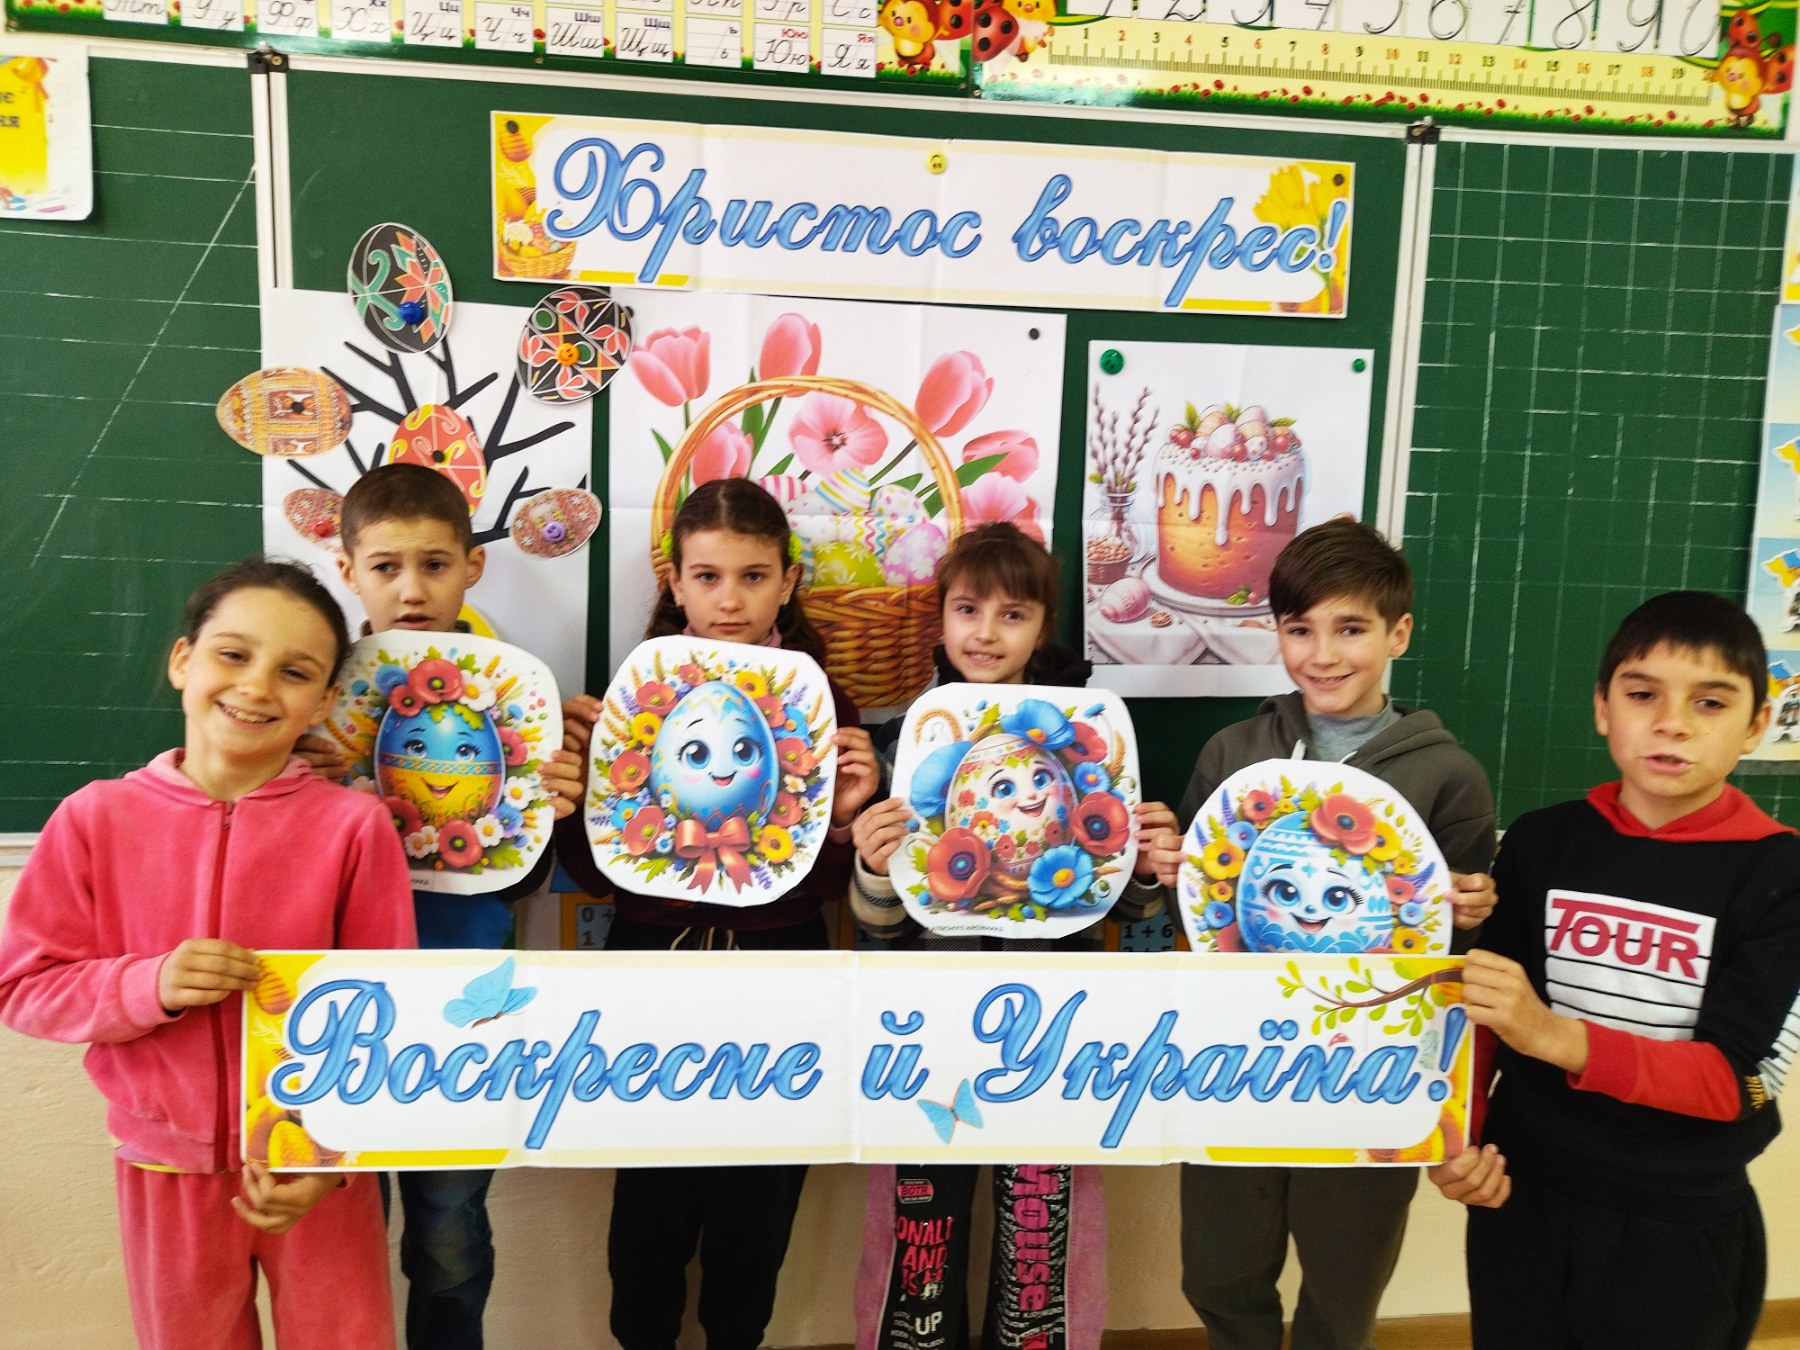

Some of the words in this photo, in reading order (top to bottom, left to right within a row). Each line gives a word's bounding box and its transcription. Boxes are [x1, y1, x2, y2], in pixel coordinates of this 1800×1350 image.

[781, 28, 809, 40] Юю
[857, 33, 876, 44] Яя
[1083, 27, 1089, 39] 1
[1118, 29, 1127, 41] 2
[1152, 32, 1161, 44] 3
[1184, 34, 1193, 45] 4
[1220, 36, 1230, 48] 5
[1254, 38, 1263, 49] 6
[1288, 40, 1297, 52] 7
[1321, 43, 1330, 55] 8
[1355, 45, 1364, 57] 9
[1417, 50, 1429, 62] 11
[1449, 53, 1462, 65] 12
[1482, 55, 1496, 67] 13
[1607, 63, 1622, 76] 17
[546, 136, 982, 284] Христос
[1012, 173, 1348, 308] воскрес!
[1549, 897, 1702, 980] TOUR
[270, 977, 824, 1151] Воскресне
[860, 1009, 929, 1101] й
[972, 981, 1468, 1149] Україна!
[915, 1310, 943, 1336] UP
